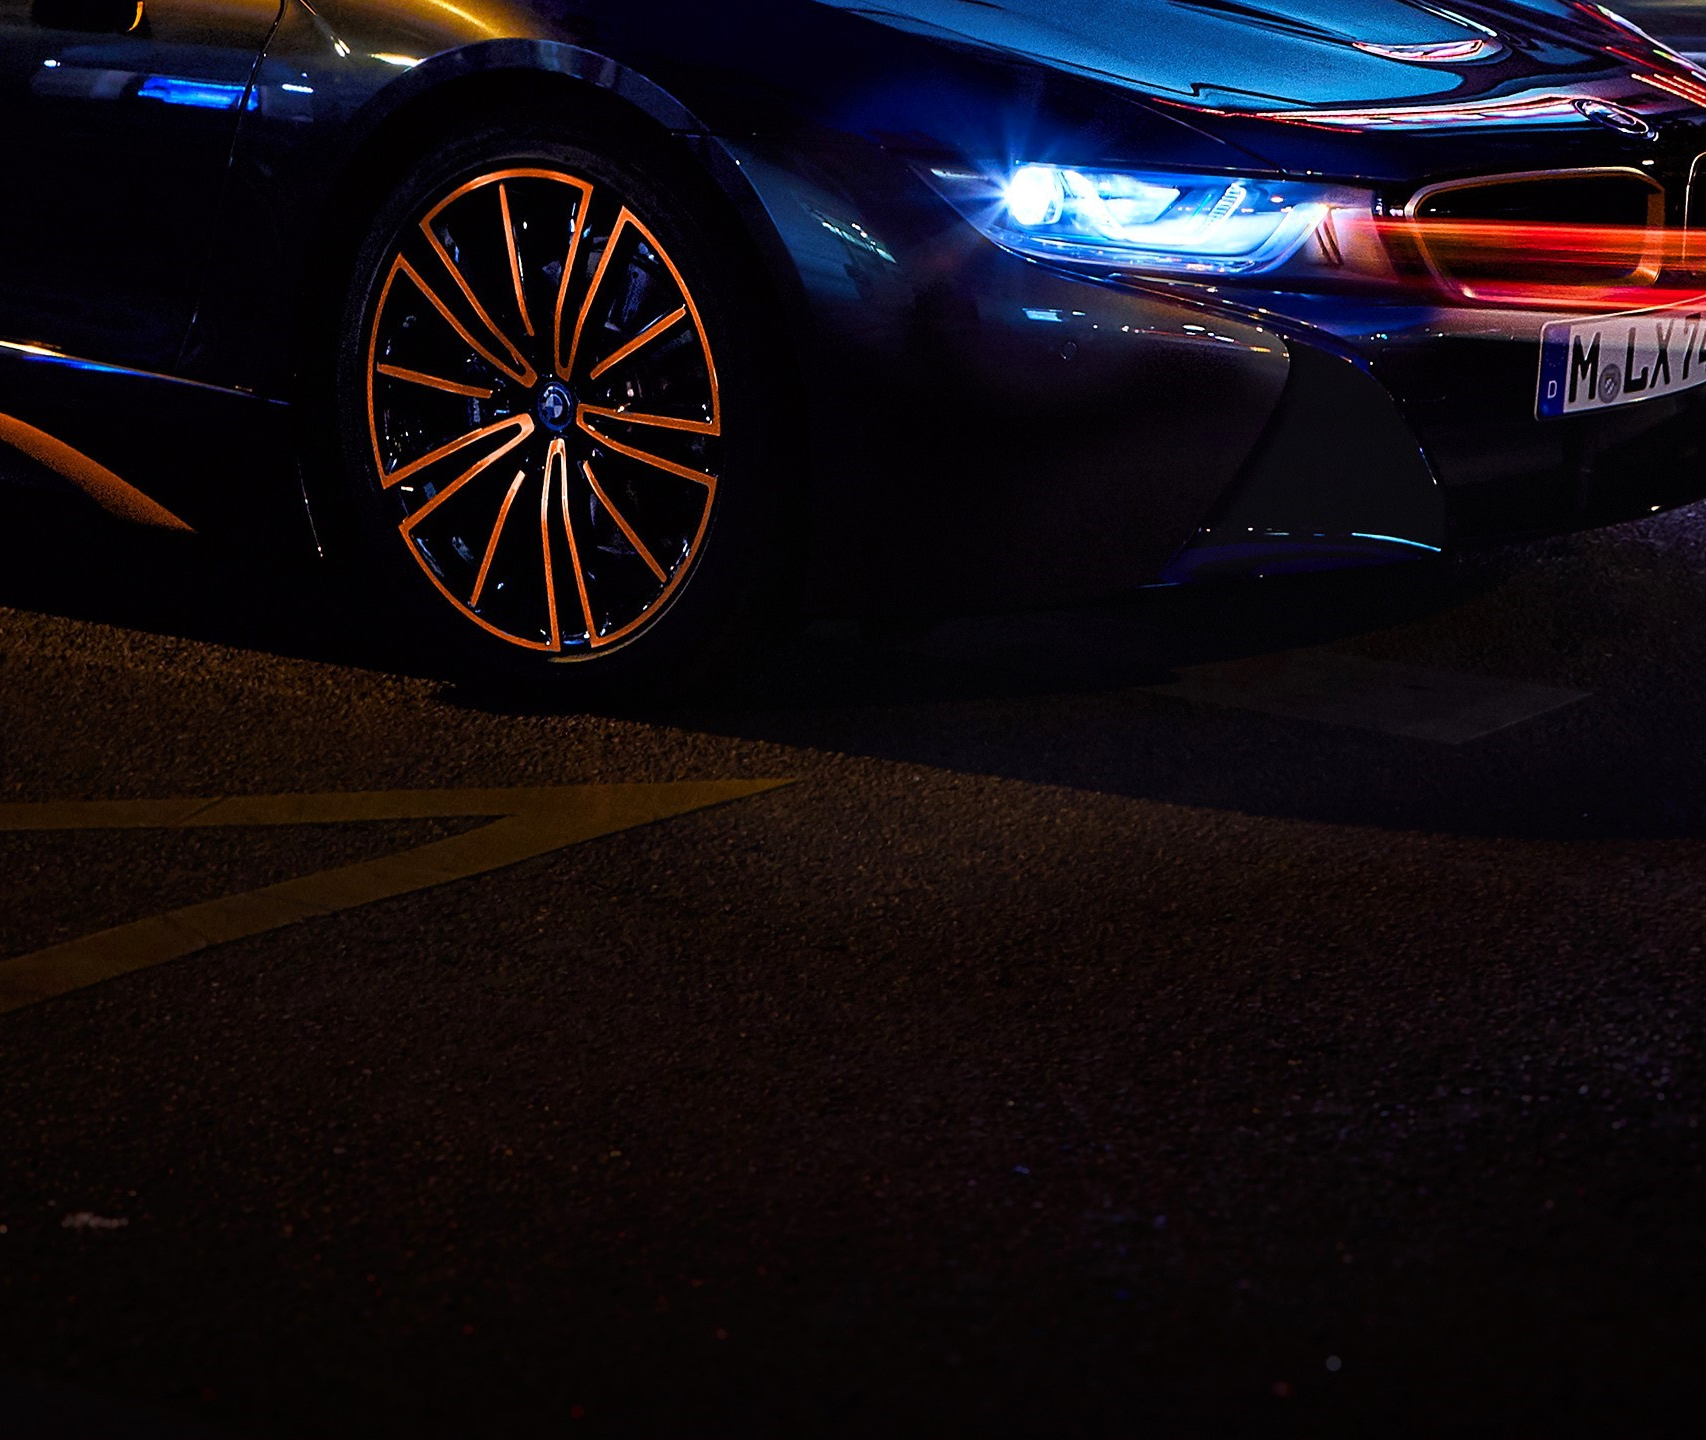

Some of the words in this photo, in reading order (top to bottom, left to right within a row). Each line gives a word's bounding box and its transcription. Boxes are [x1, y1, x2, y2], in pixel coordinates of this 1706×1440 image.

[1568, 331, 1601, 403] M
[1622, 318, 1675, 393] LX
[1547, 379, 1558, 399] D
